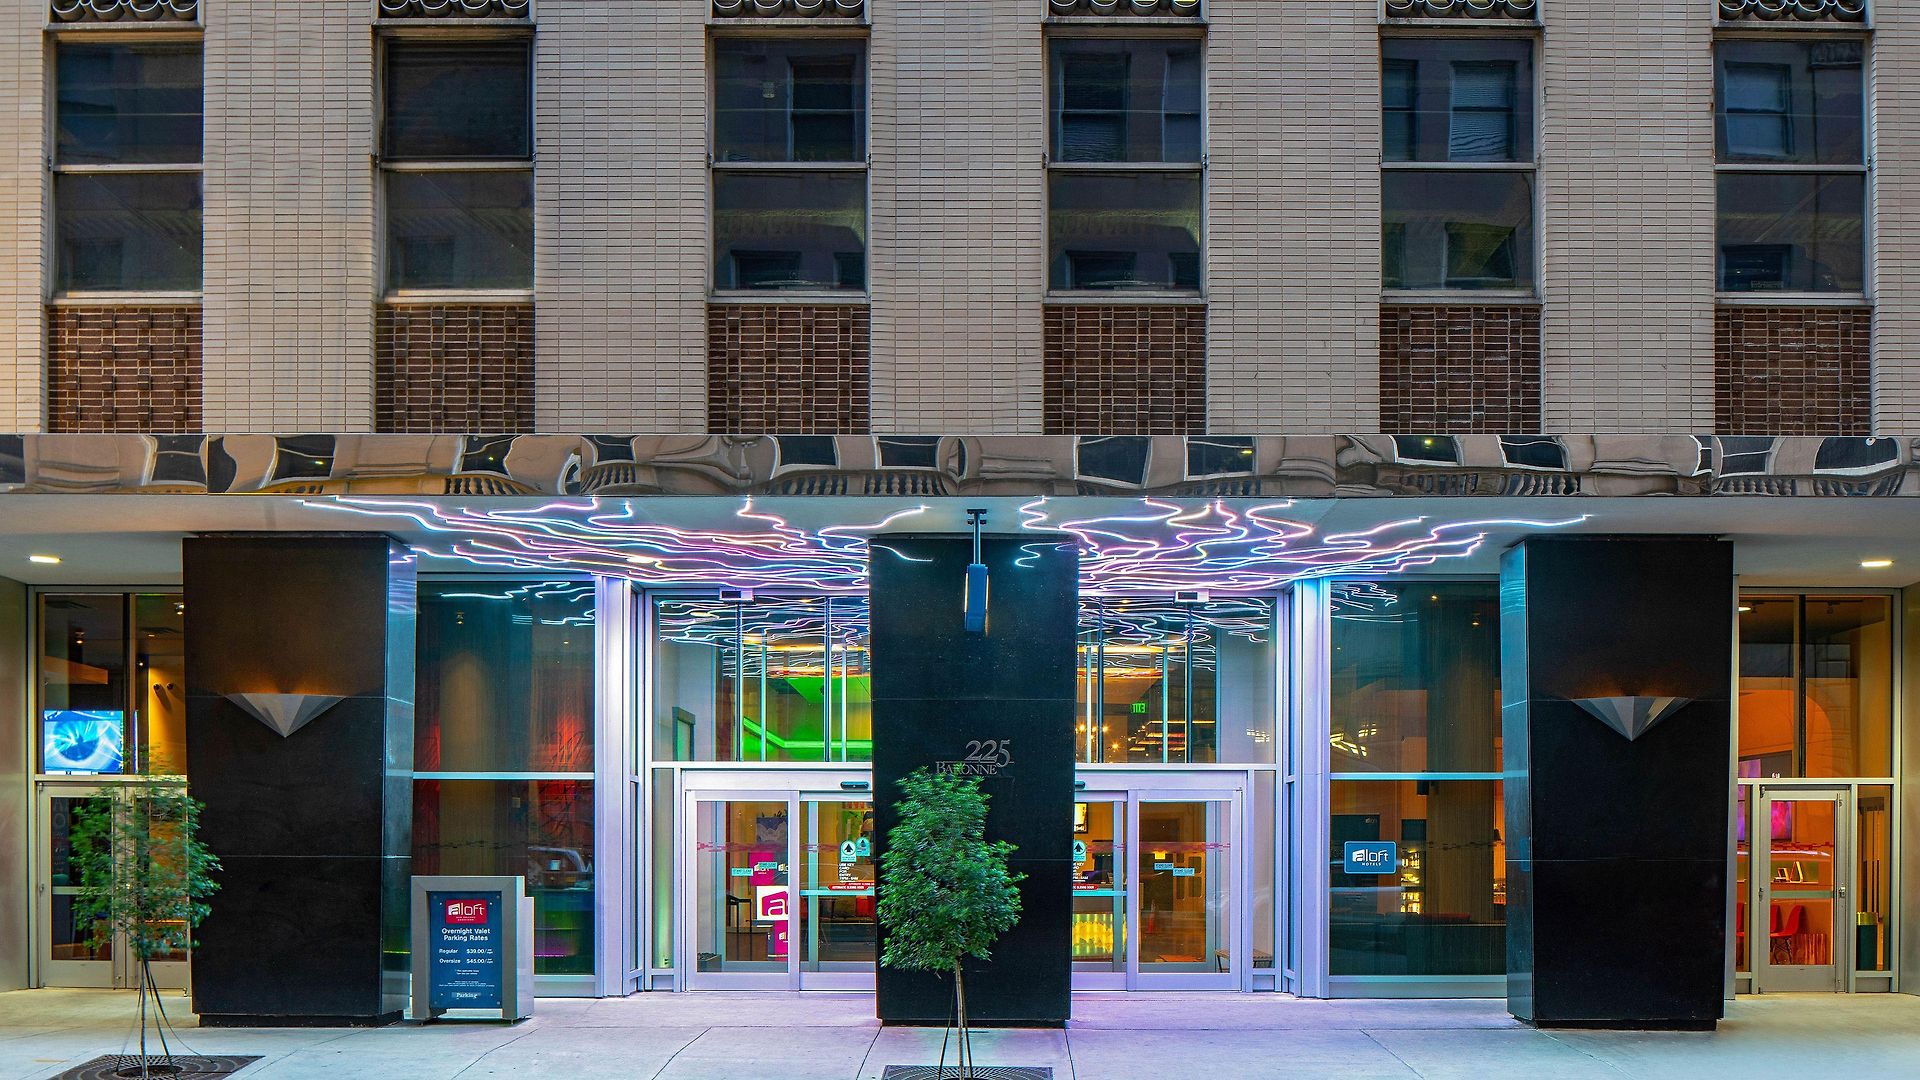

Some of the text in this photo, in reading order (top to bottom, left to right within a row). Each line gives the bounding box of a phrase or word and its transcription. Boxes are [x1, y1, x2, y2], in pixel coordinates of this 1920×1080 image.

[964, 739, 1011, 767] 225
[1352, 848, 1389, 862] aloft
[447, 902, 484, 916] aloft
[441, 927, 473, 935] Overnight
[443, 934, 468, 942] Parking
